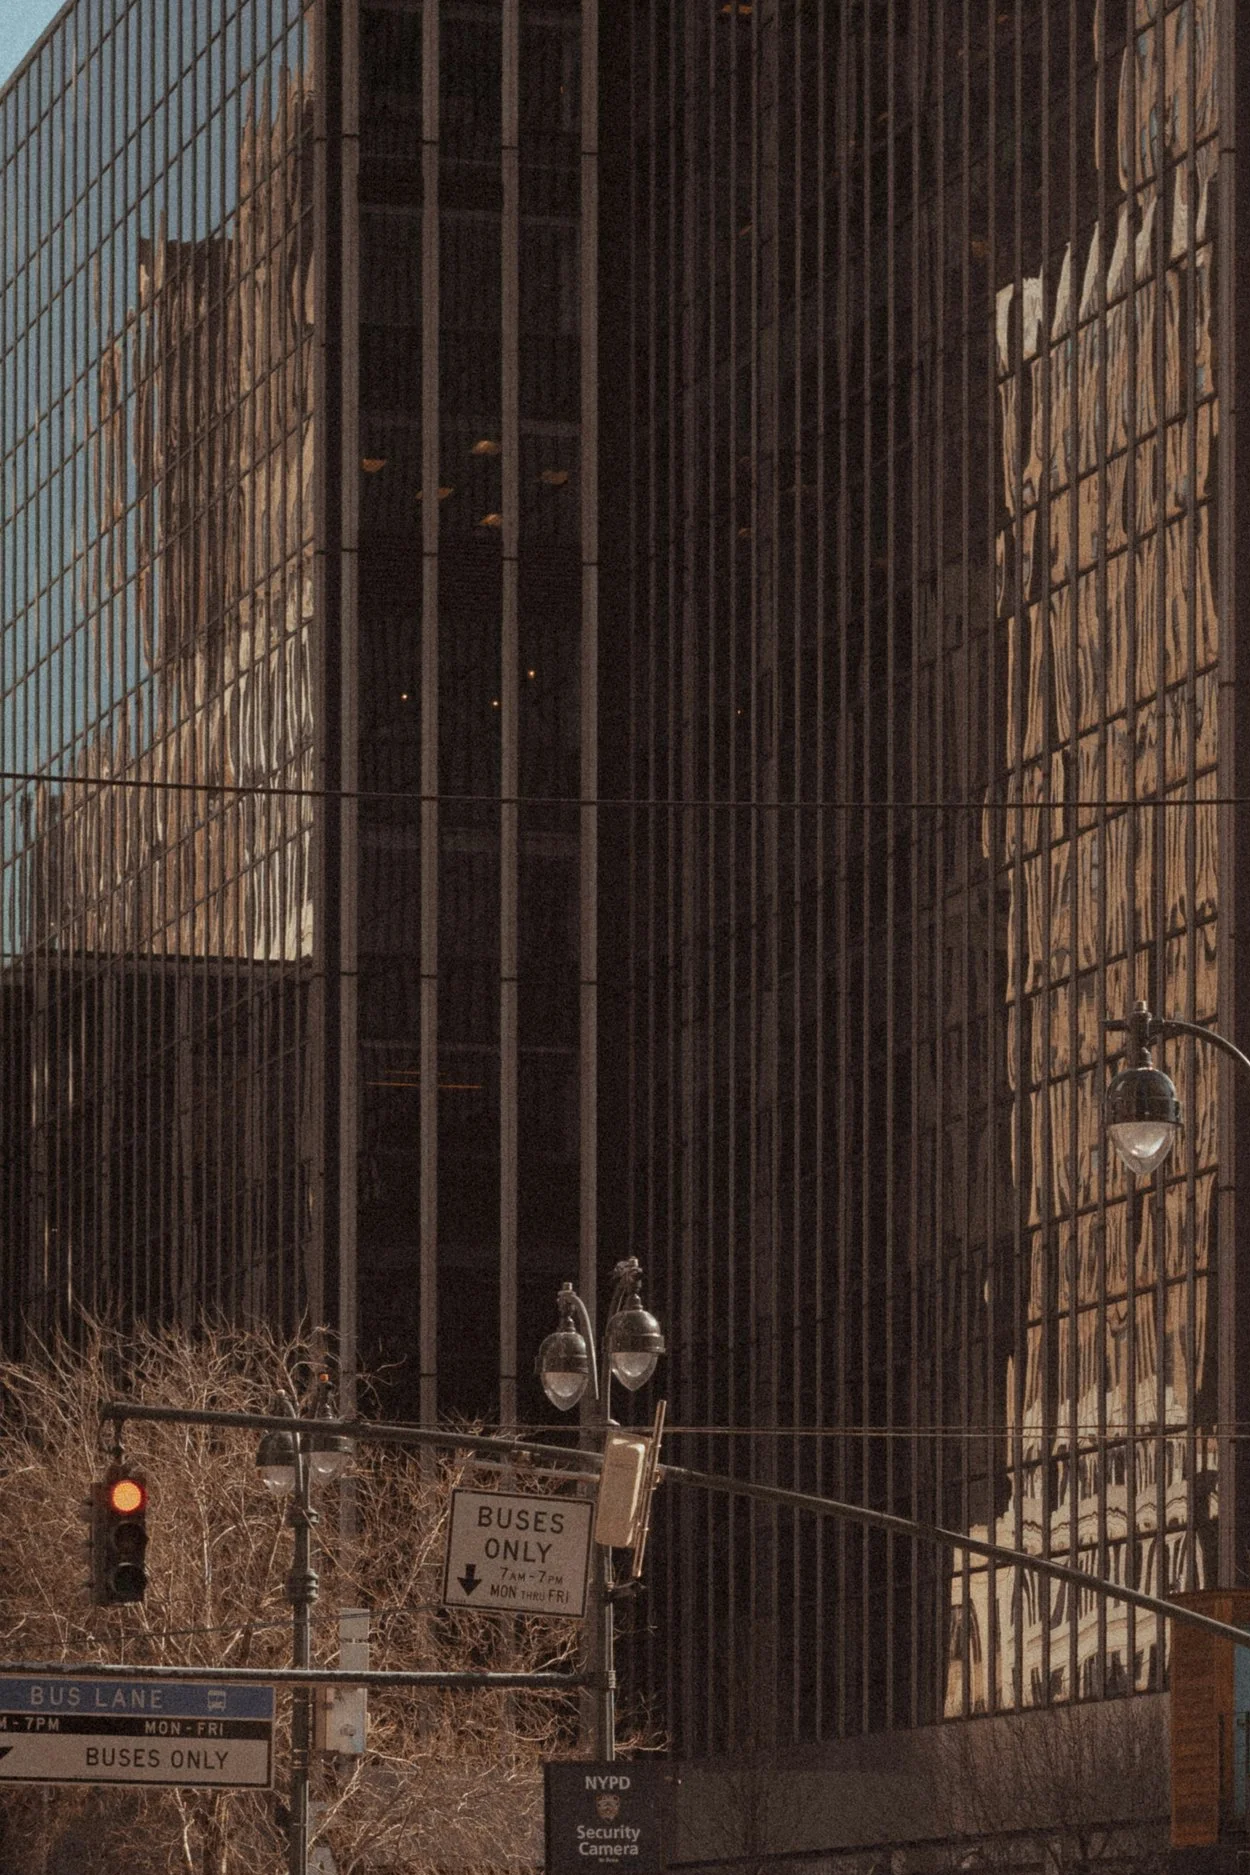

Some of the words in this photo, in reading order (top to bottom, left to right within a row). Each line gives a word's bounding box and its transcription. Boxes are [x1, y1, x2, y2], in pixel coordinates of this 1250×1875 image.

[477, 1506, 565, 1535] BUSES
[484, 1538, 552, 1564] ONLY
[490, 1585, 518, 1599] MON
[521, 1591, 546, 1602] THRU
[548, 1589, 569, 1604] FRI
[29, 1685, 81, 1707] BUS
[94, 1688, 163, 1710] LANE
[86, 1747, 160, 1769] BUSES
[171, 1750, 229, 1770] ONLY
[585, 1775, 631, 1791] NYPD
[576, 1824, 641, 1843] Security
[578, 1841, 639, 1856] Camera
